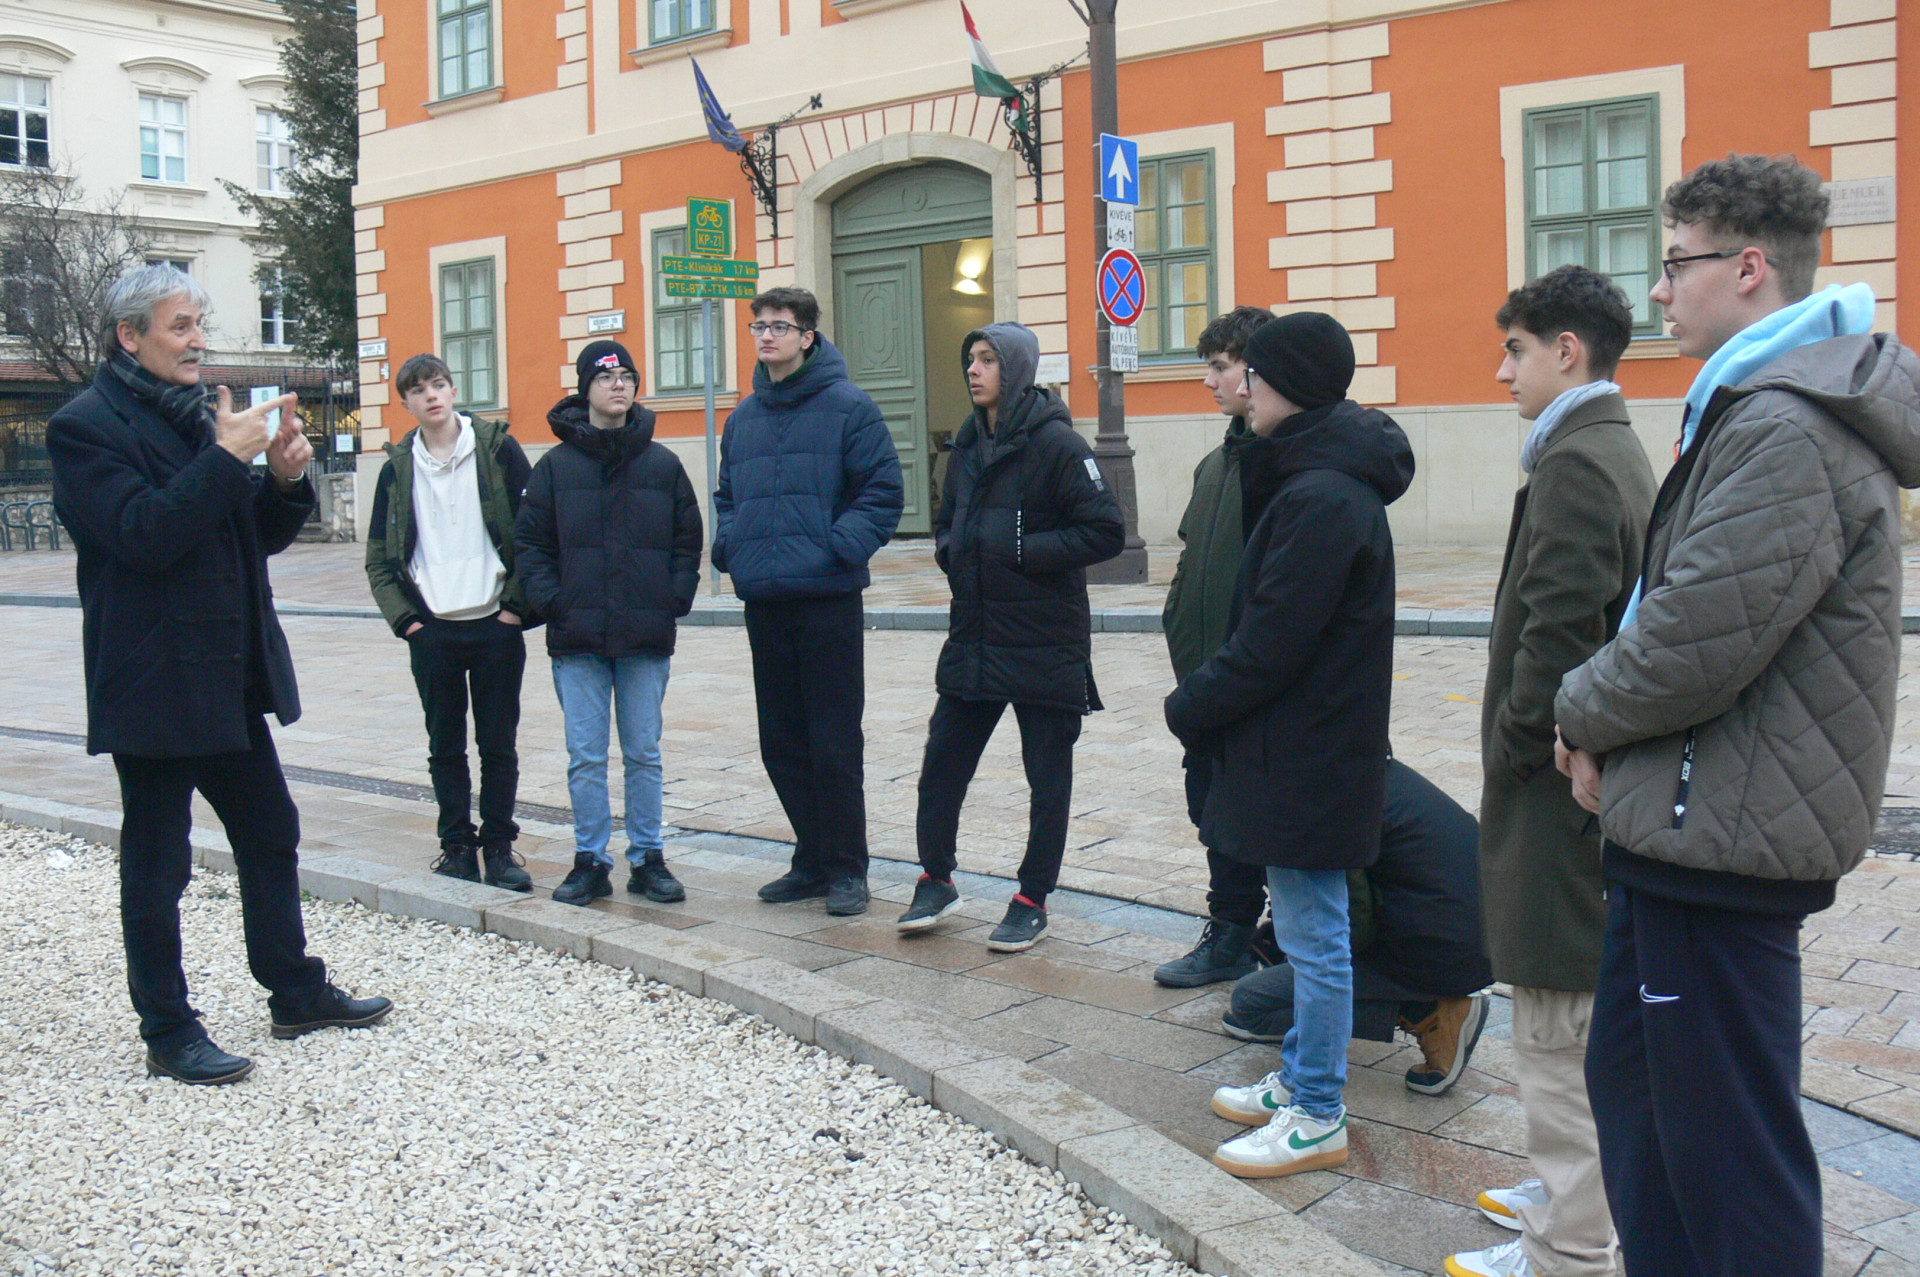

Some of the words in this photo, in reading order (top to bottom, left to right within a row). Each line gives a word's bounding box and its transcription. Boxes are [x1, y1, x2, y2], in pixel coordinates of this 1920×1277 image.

[1109, 208, 1132, 221] KIVÉVE
[699, 233, 722, 248] KP-21
[665, 260, 724, 274] PTE-Klinikák
[734, 264, 745, 276] 1,7
[746, 265, 757, 276] km
[669, 282, 730, 295] PTE-BTK-TTK
[745, 286, 756, 296] km
[1111, 343, 1137, 356] AUTÓBUSZ
[1121, 357, 1137, 369] PERC
[1680, 760, 1691, 782] BOX
